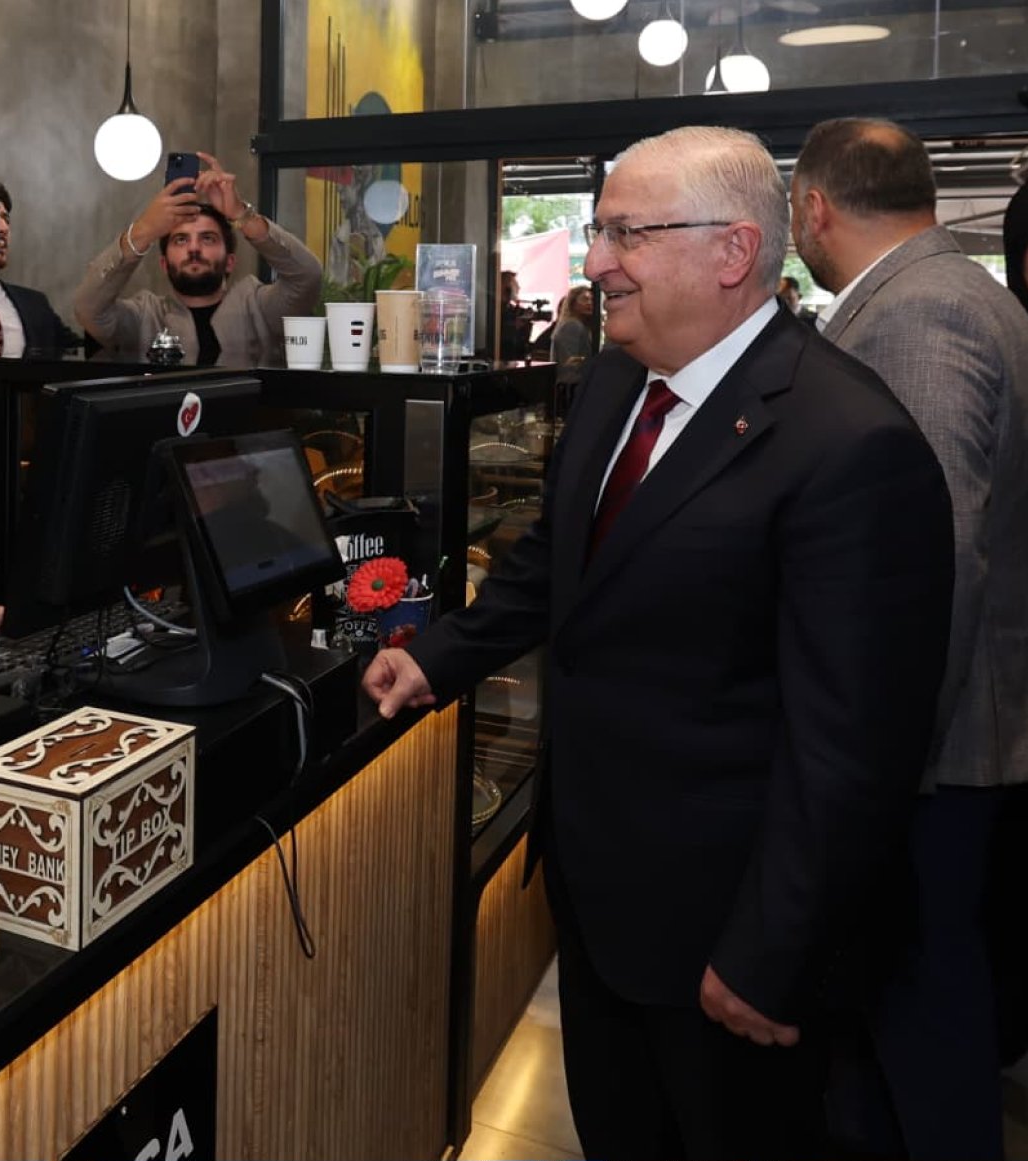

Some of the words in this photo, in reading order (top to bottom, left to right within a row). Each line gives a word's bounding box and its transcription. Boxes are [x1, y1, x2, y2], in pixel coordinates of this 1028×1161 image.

[110, 829, 135, 864] TIP
[141, 807, 172, 839] BOX
[28, 855, 65, 882] BANK
